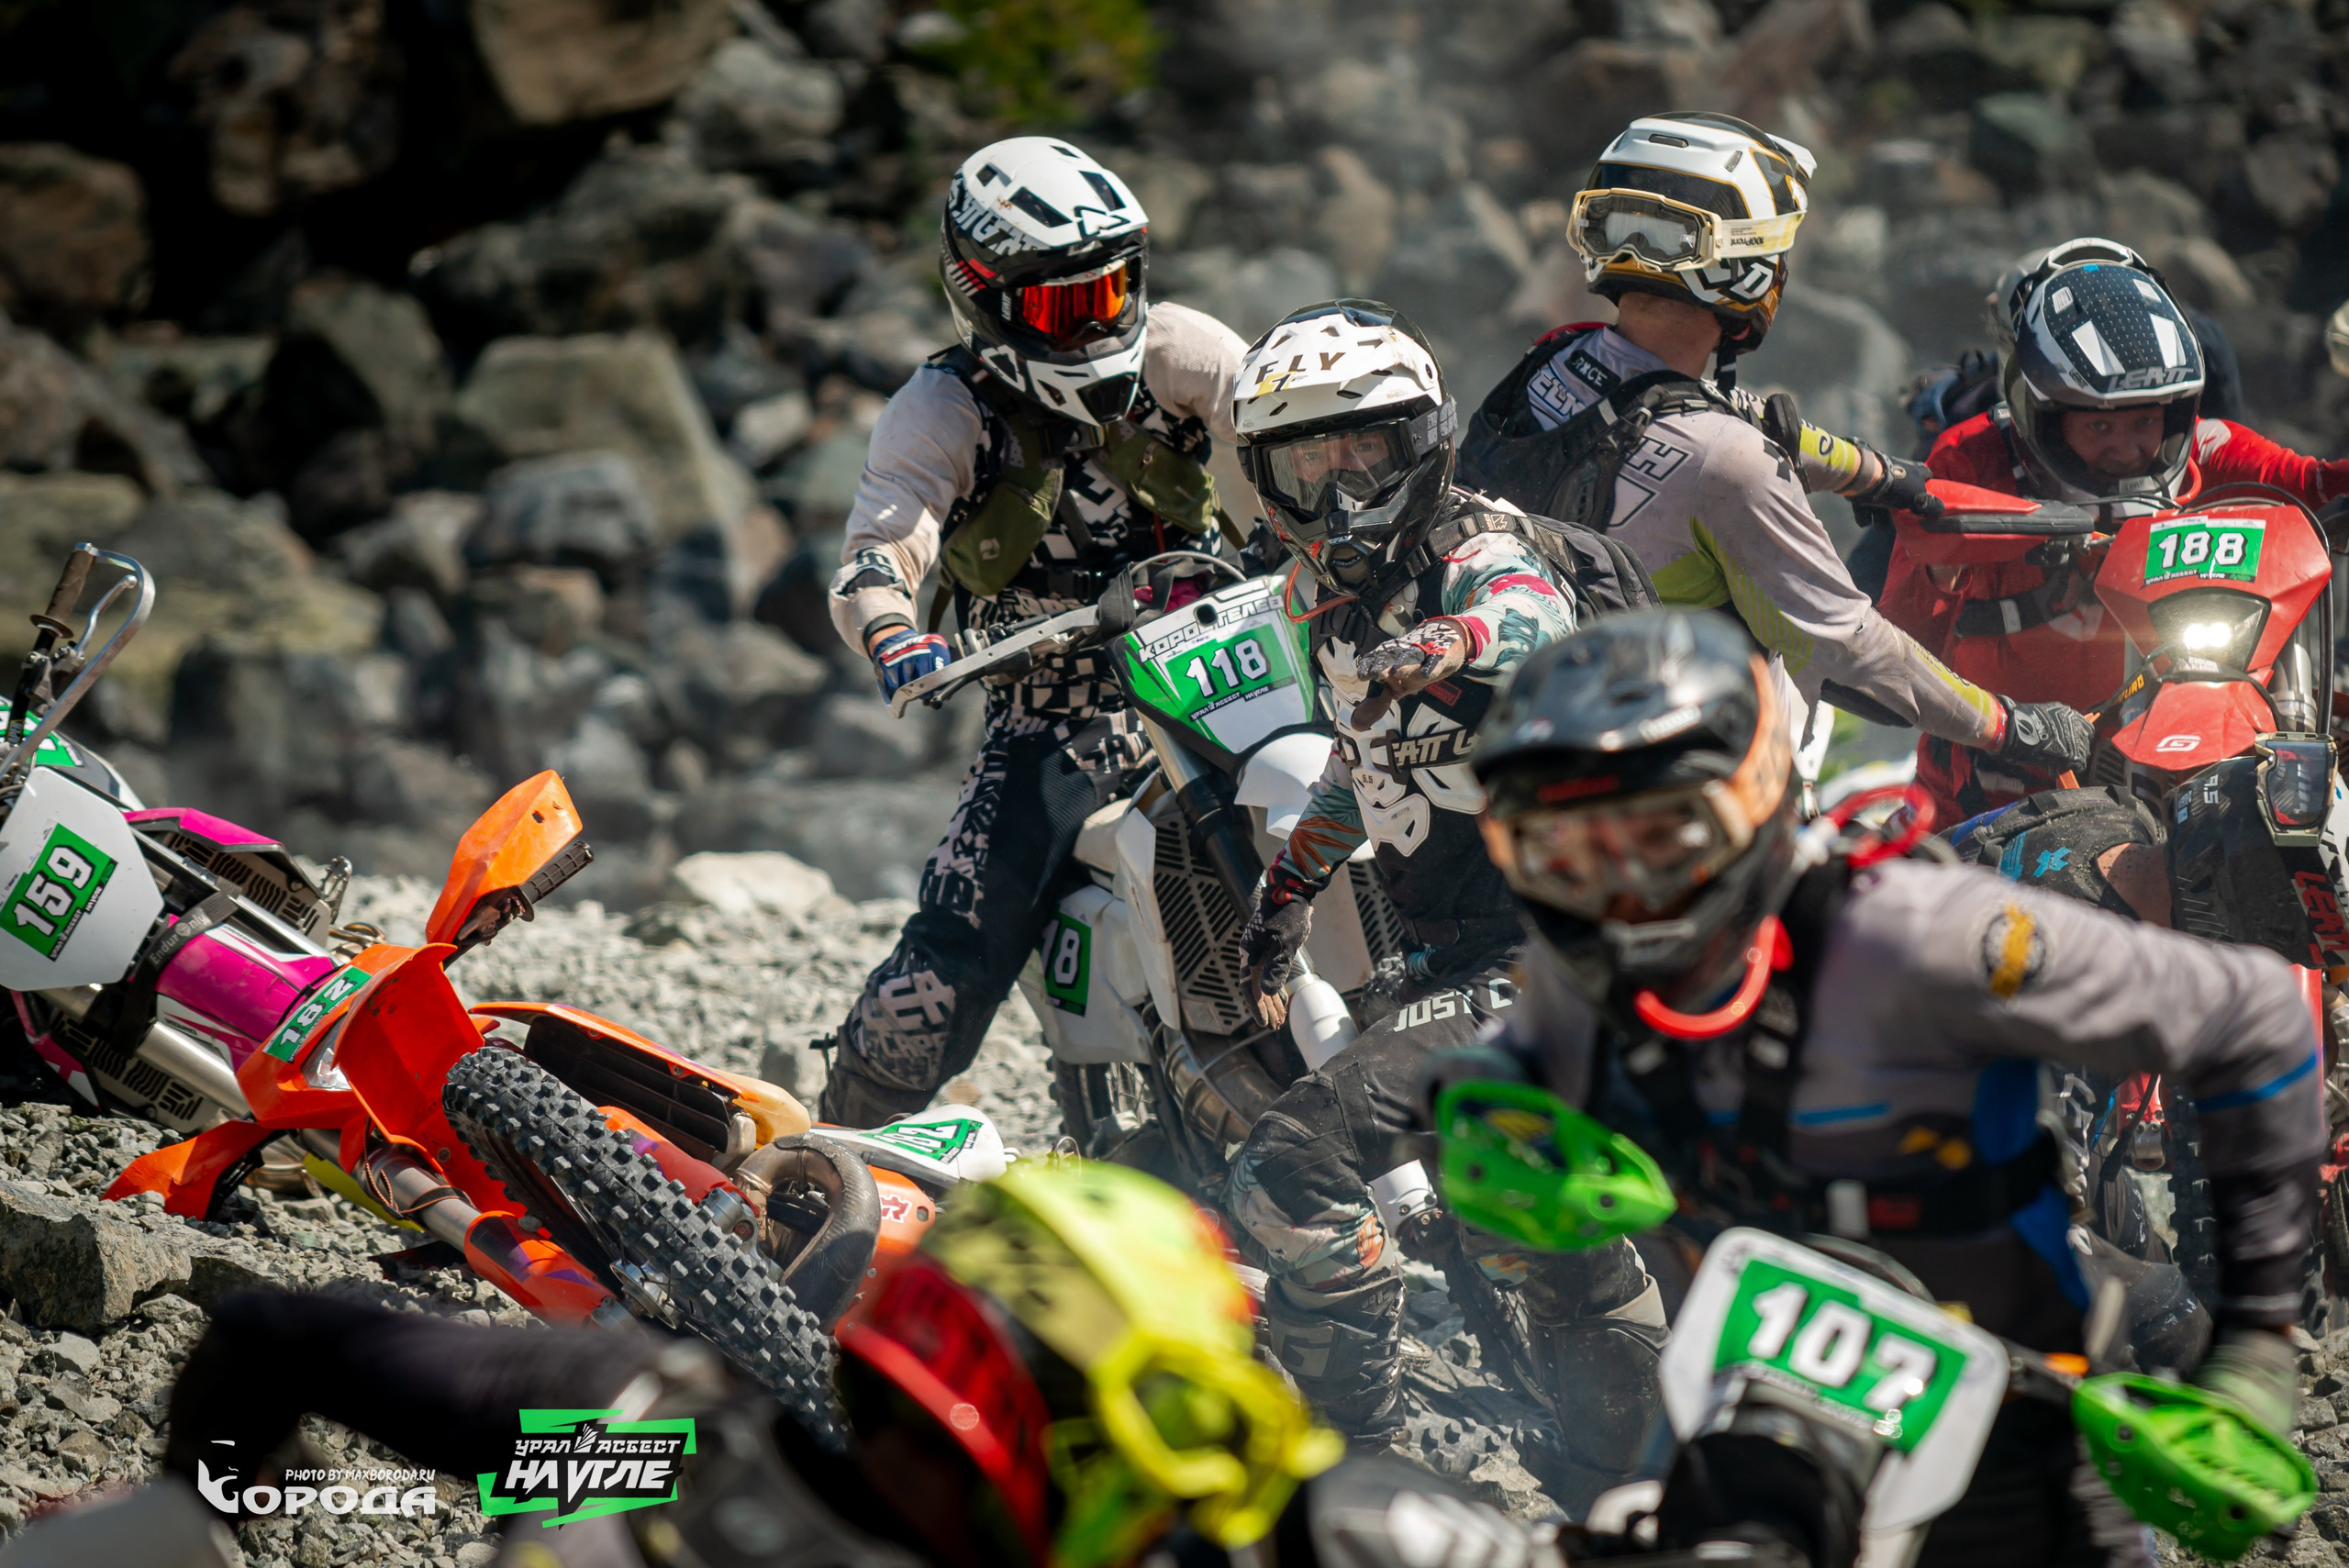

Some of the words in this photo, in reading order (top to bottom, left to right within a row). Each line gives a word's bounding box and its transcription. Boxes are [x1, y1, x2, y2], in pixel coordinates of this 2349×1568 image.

[1254, 352, 1346, 384] FLY
[2108, 366, 2194, 393] LEATT
[2158, 531, 2248, 569] 188
[1138, 595, 1284, 663] КОРОТЕЛЕВ
[1186, 638, 1272, 699] 118
[1391, 734, 1451, 763] EATT
[1363, 774, 1374, 784] 5.5
[13, 844, 96, 937] 159
[280, 976, 357, 1045] 182
[1393, 989, 1474, 1033] JUST
[1748, 1281, 1938, 1412] 107
